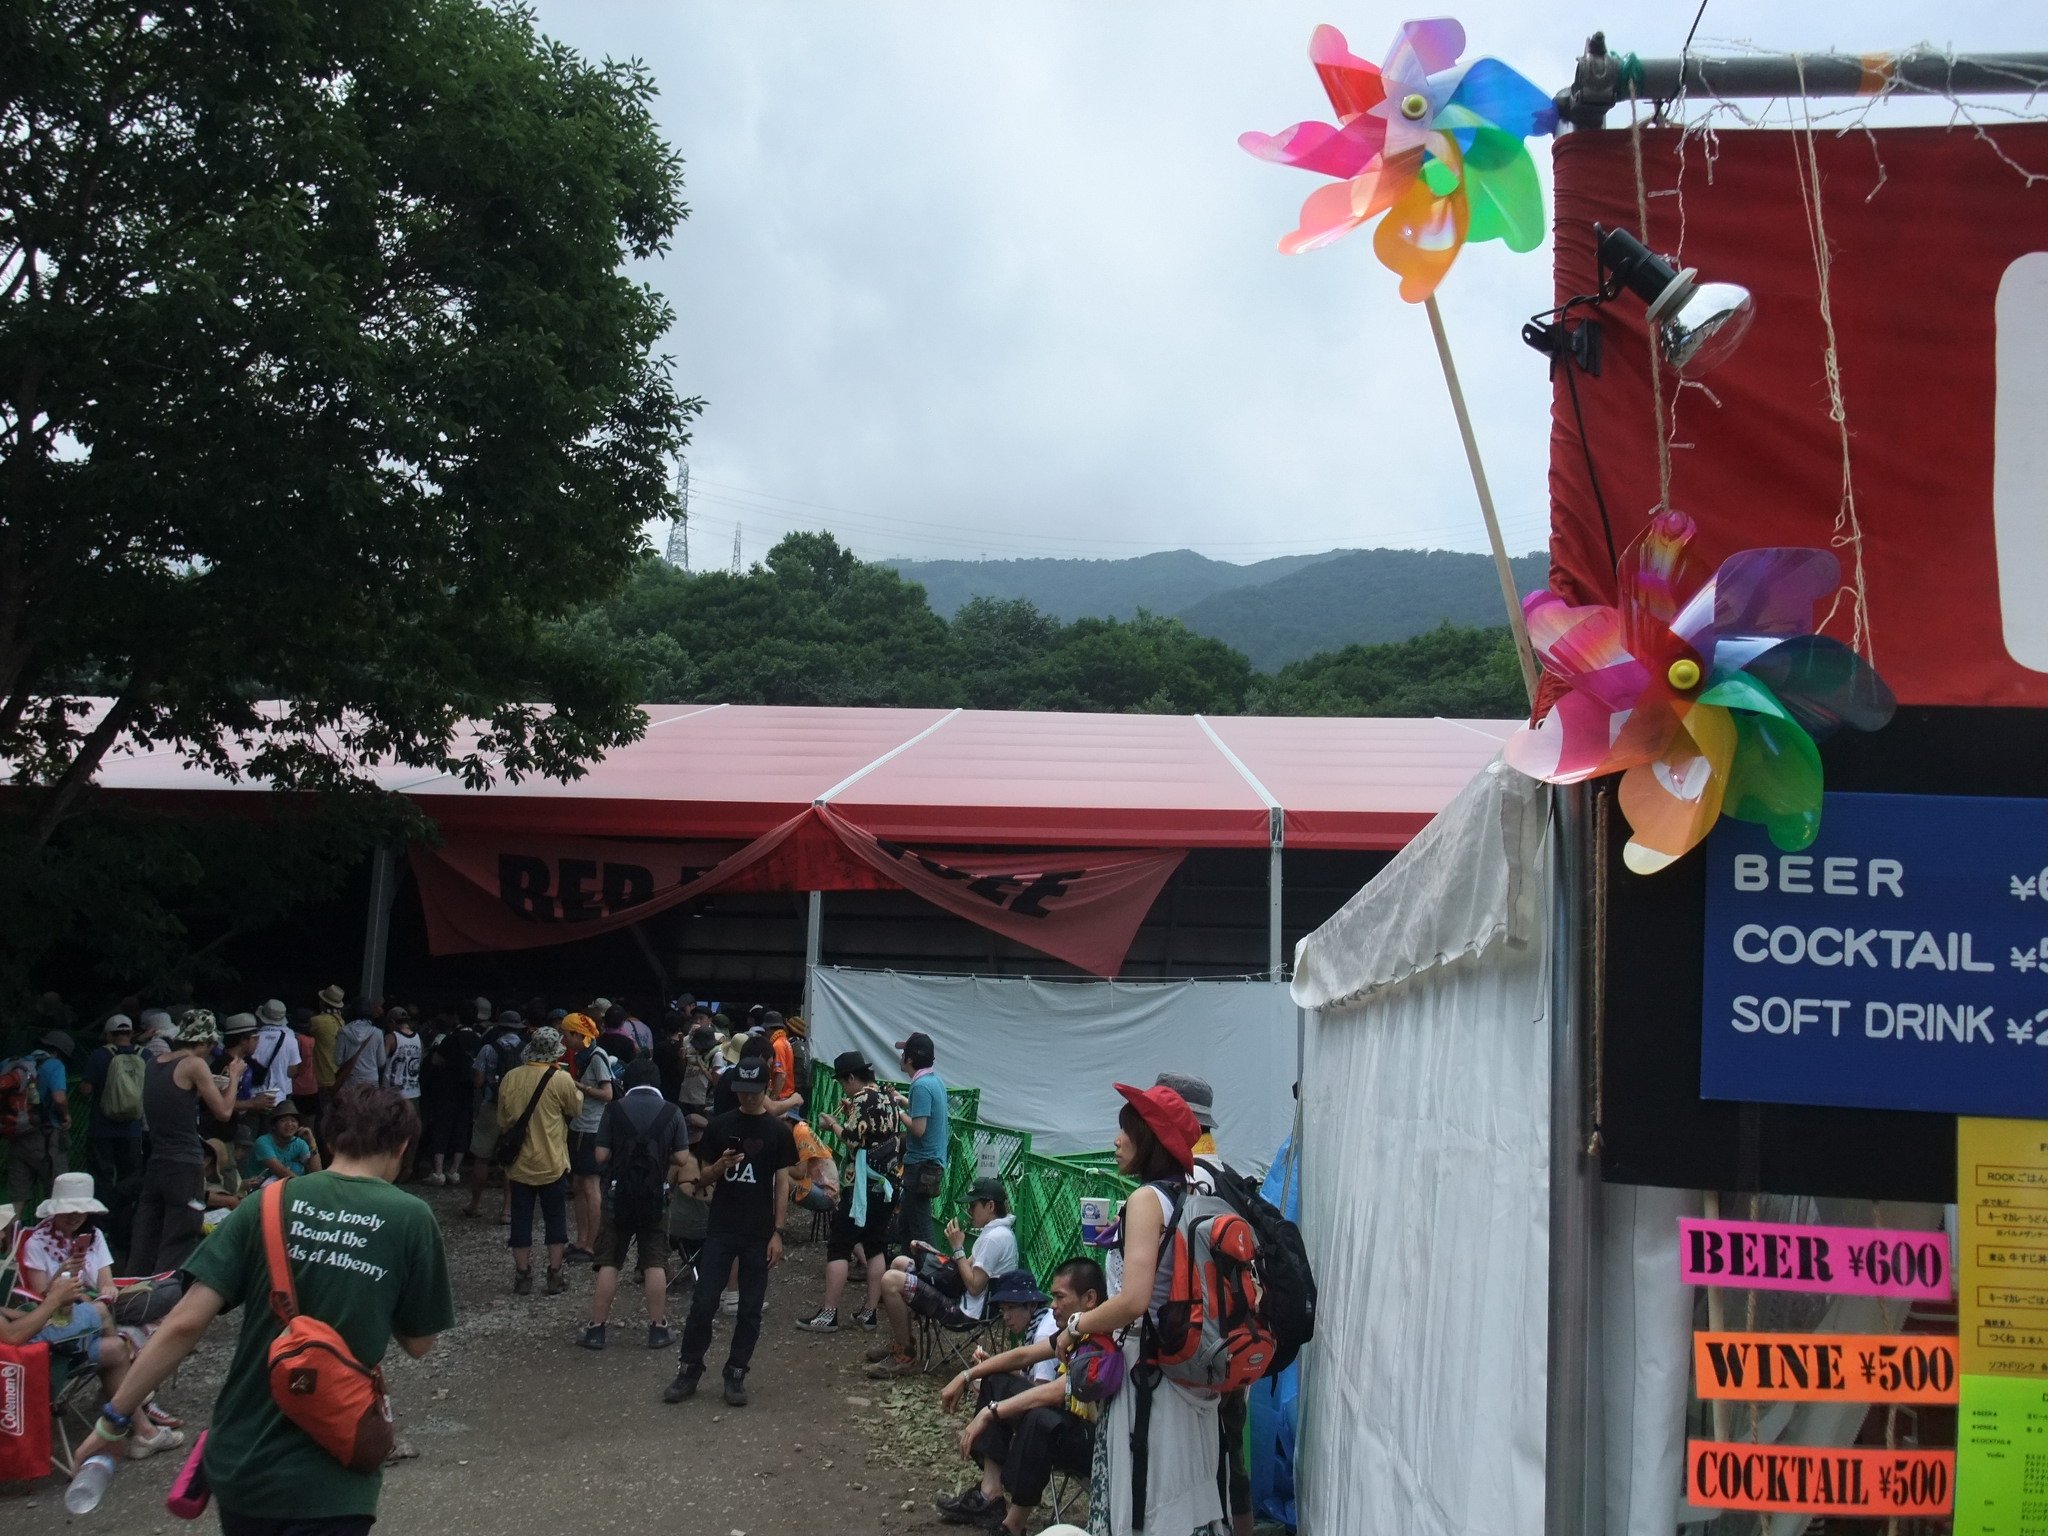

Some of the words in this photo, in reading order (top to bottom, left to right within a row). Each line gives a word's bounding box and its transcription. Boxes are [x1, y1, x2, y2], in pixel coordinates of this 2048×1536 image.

[499, 853, 654, 923] RED
[1734, 854, 1904, 898] BEER
[1733, 924, 1996, 972] COCKTAIL
[1731, 995, 1851, 1037] SOFT
[1865, 1002, 1995, 1044] DRINK
[290, 1220, 341, 1243] Round
[342, 1231, 368, 1248] the
[291, 1199, 315, 1216] It's
[316, 1210, 335, 1221] so
[337, 1209, 386, 1232] lonely
[308, 1249, 326, 1263] of
[324, 1251, 388, 1282] Athenry
[1688, 1230, 1833, 1282] BEER
[1848, 1240, 1942, 1288] ¥600
[1989, 1293, 2048, 1305] キーマカレーごは
[1705, 1343, 1845, 1390] WINE
[1858, 1345, 1954, 1391] ¥500
[0, 1378, 17, 1429] Coleman
[1696, 1451, 1869, 1505] COCKTAIL
[1879, 1459, 1947, 1506] ¥500
